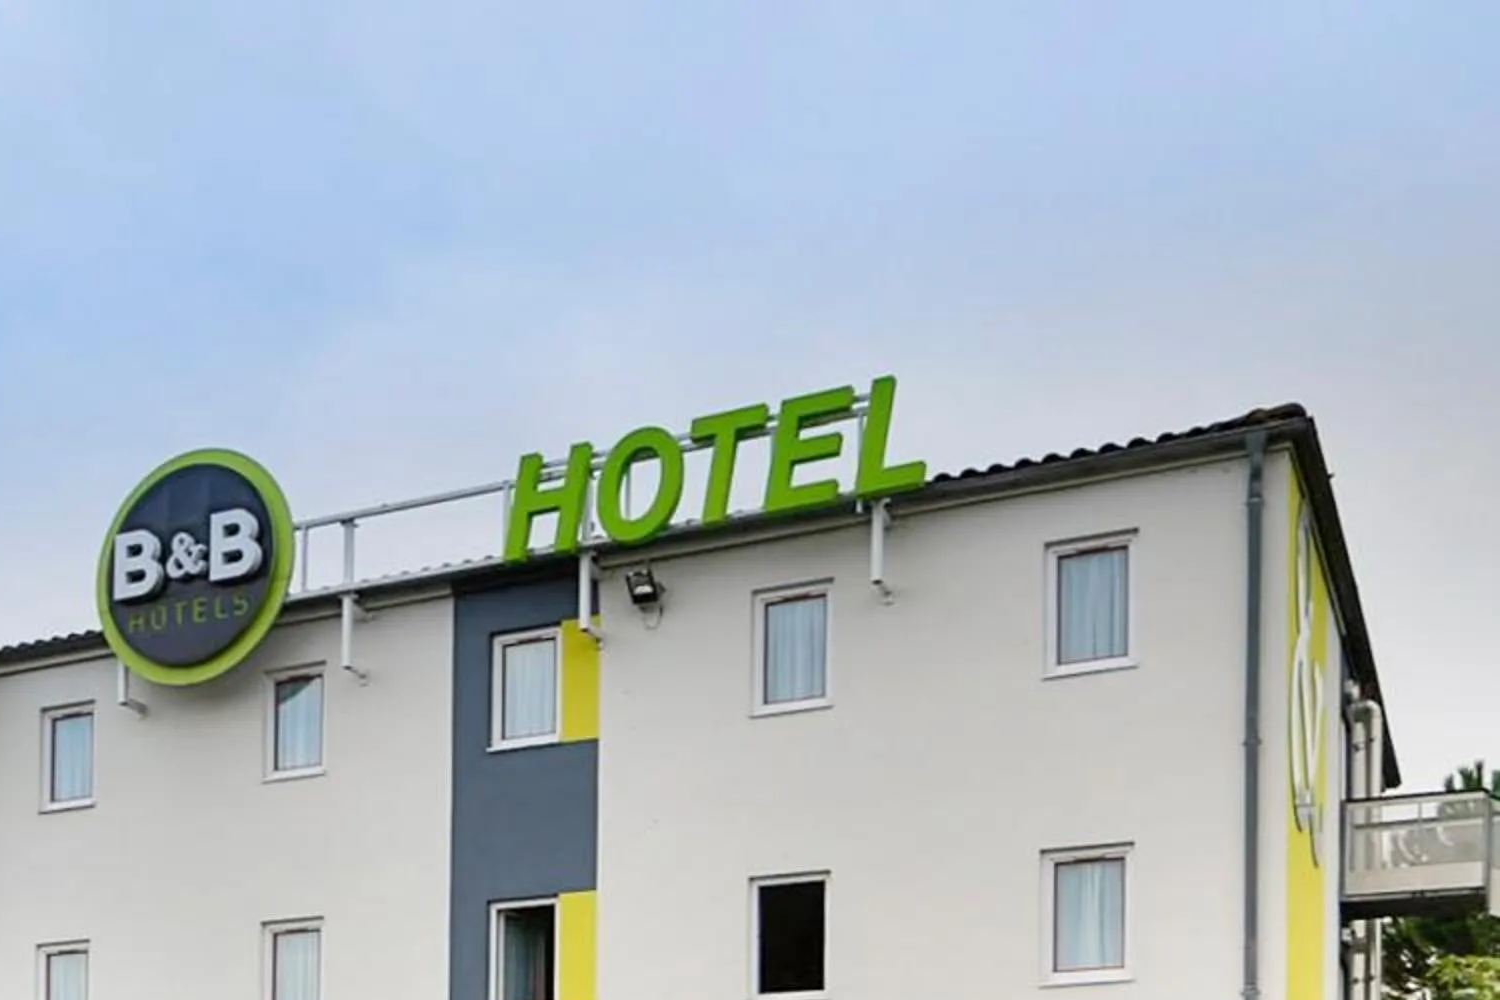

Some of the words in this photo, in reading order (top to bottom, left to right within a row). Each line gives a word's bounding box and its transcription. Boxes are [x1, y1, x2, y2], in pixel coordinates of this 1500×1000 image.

[503, 375, 927, 564] HOTEL
[113, 508, 263, 601] B&B
[129, 594, 250, 632] HOTELS
